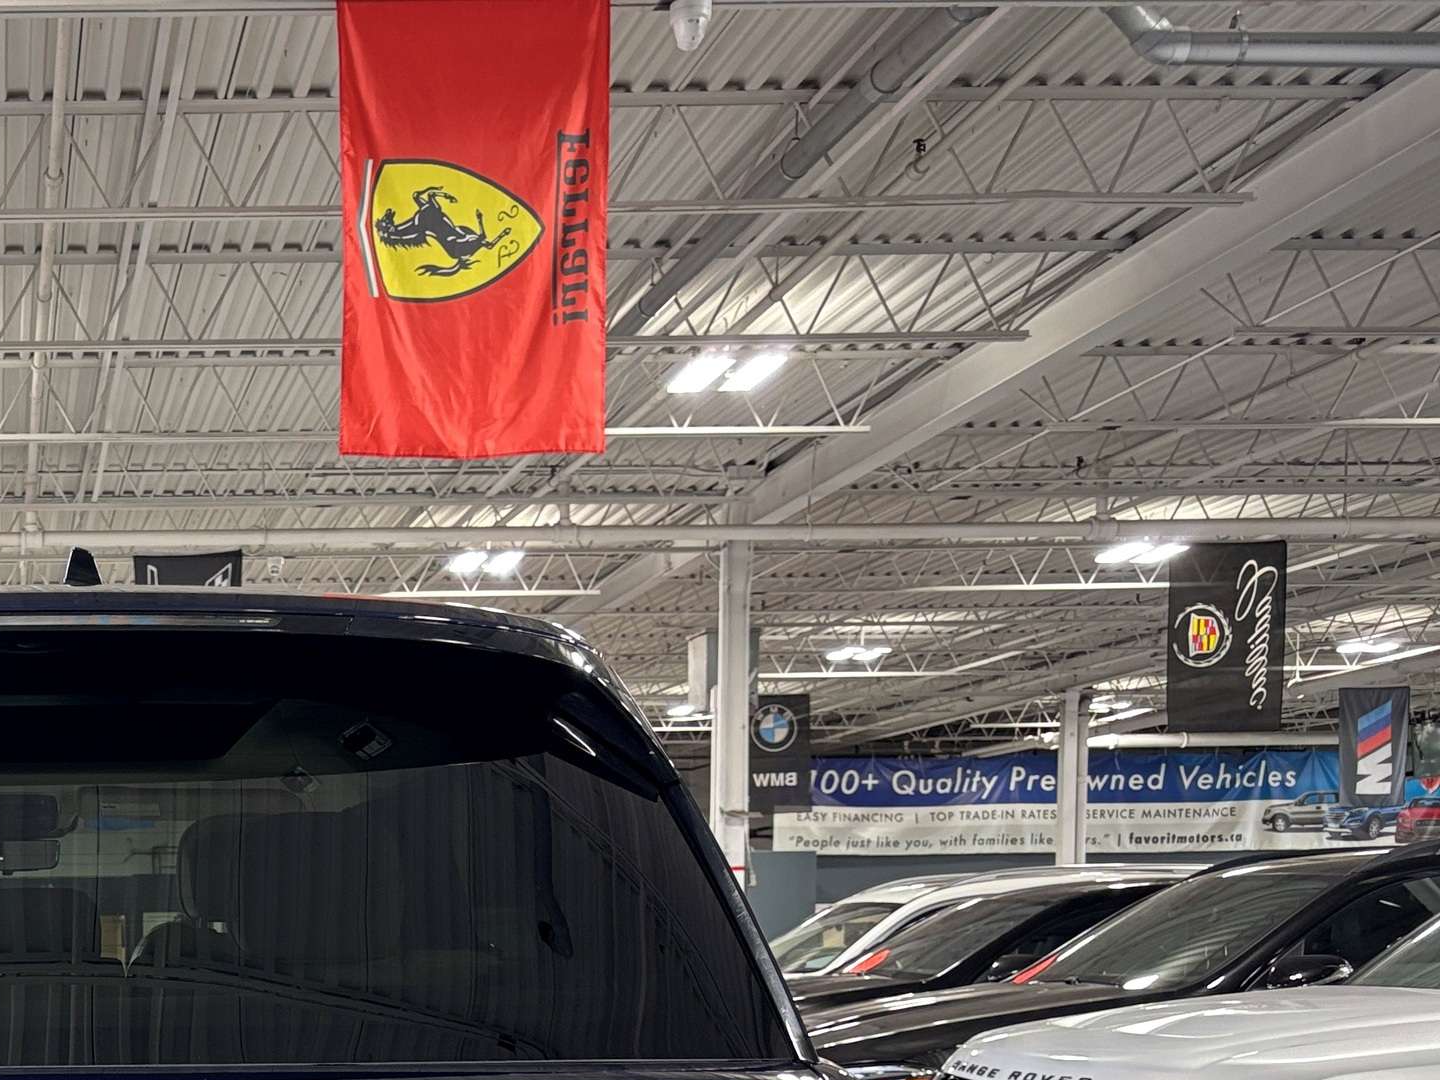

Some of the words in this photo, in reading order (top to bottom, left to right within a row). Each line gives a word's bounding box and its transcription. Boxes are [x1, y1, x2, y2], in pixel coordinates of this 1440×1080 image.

[892, 766, 998, 799] Quality
[1179, 760, 1297, 790] Vehicles
[796, 811, 828, 822] EASY
[832, 811, 904, 823] FINANCING
[929, 811, 954, 822] TOP
[960, 809, 1015, 821] TRADE-IN
[1021, 808, 1058, 820] RATES
[1085, 808, 1136, 820] SERVICE
[1141, 806, 1237, 819] MAINTENANCE
[846, 836, 872, 850] just
[876, 835, 901, 849] like
[905, 837, 933, 850] you,
[938, 834, 967, 847] with
[972, 833, 1026, 847] families
[1029, 833, 1054, 846] like
[1129, 832, 1243, 846] favoritmotors.ca
